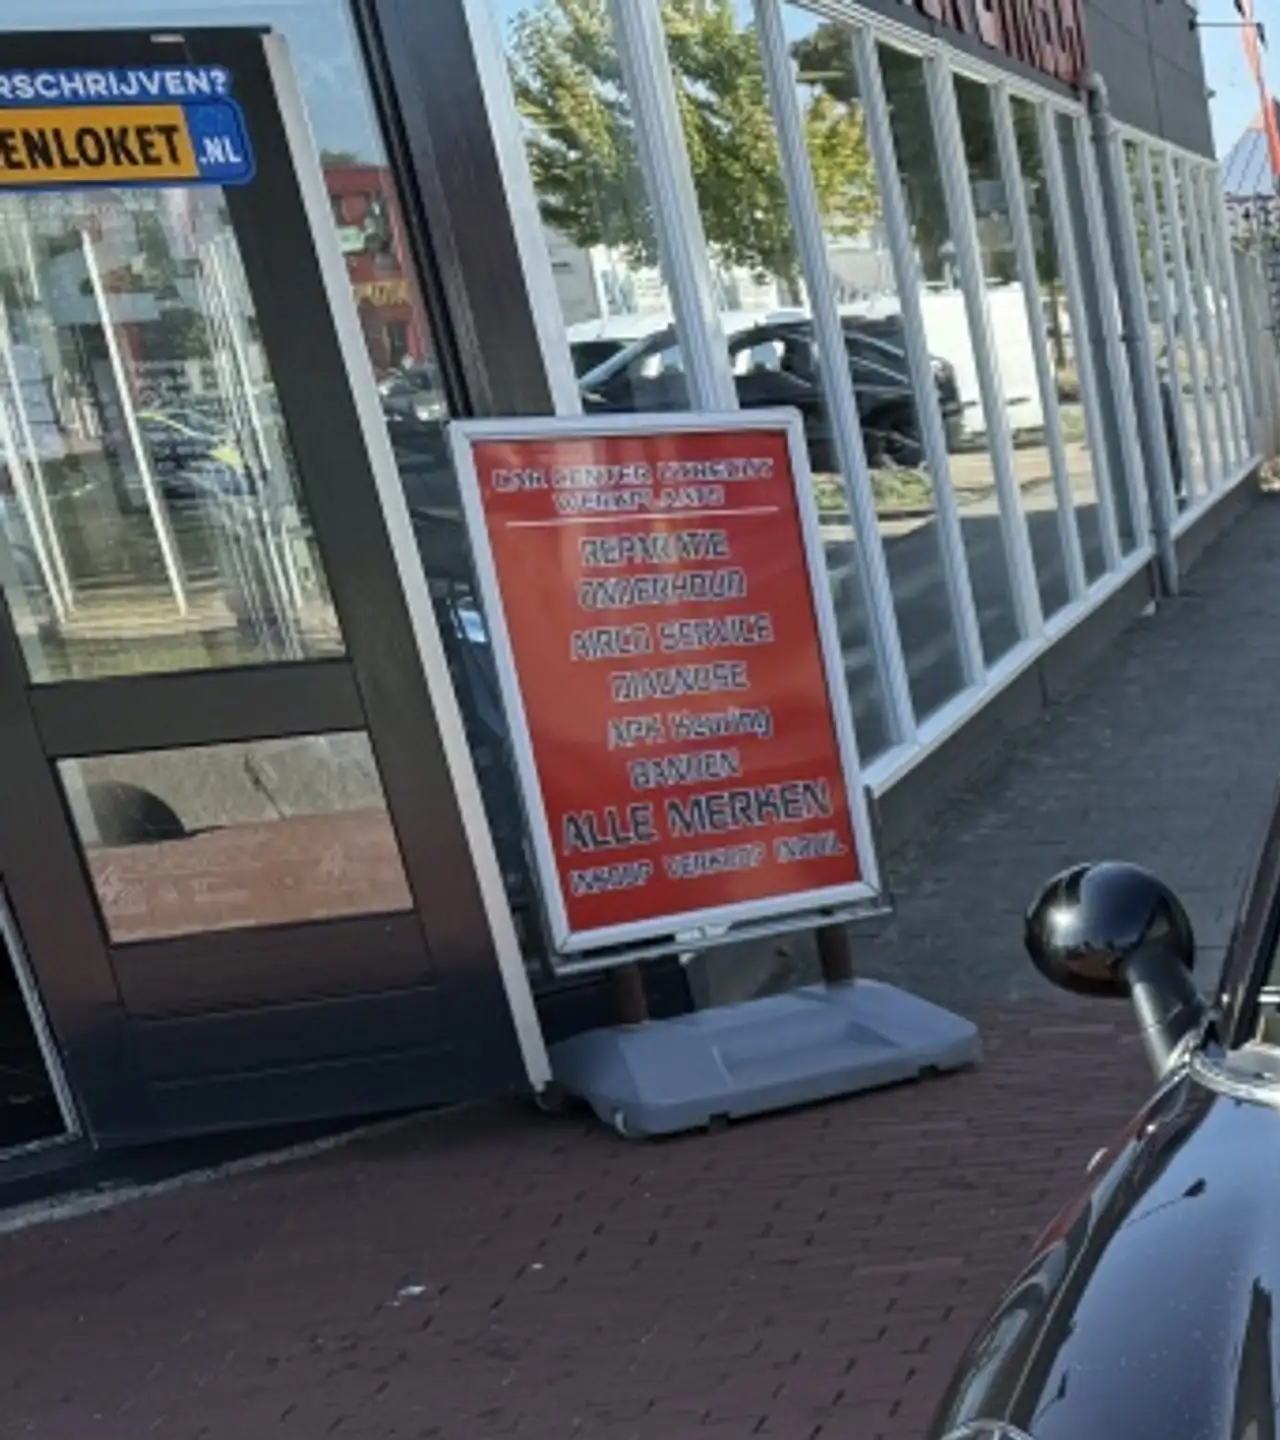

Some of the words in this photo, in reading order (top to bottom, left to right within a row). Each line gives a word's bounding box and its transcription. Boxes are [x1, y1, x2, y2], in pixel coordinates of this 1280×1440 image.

[660, 615, 775, 653] SERVICE
[562, 805, 661, 855] ALLE
[667, 780, 836, 838] MERKEN
